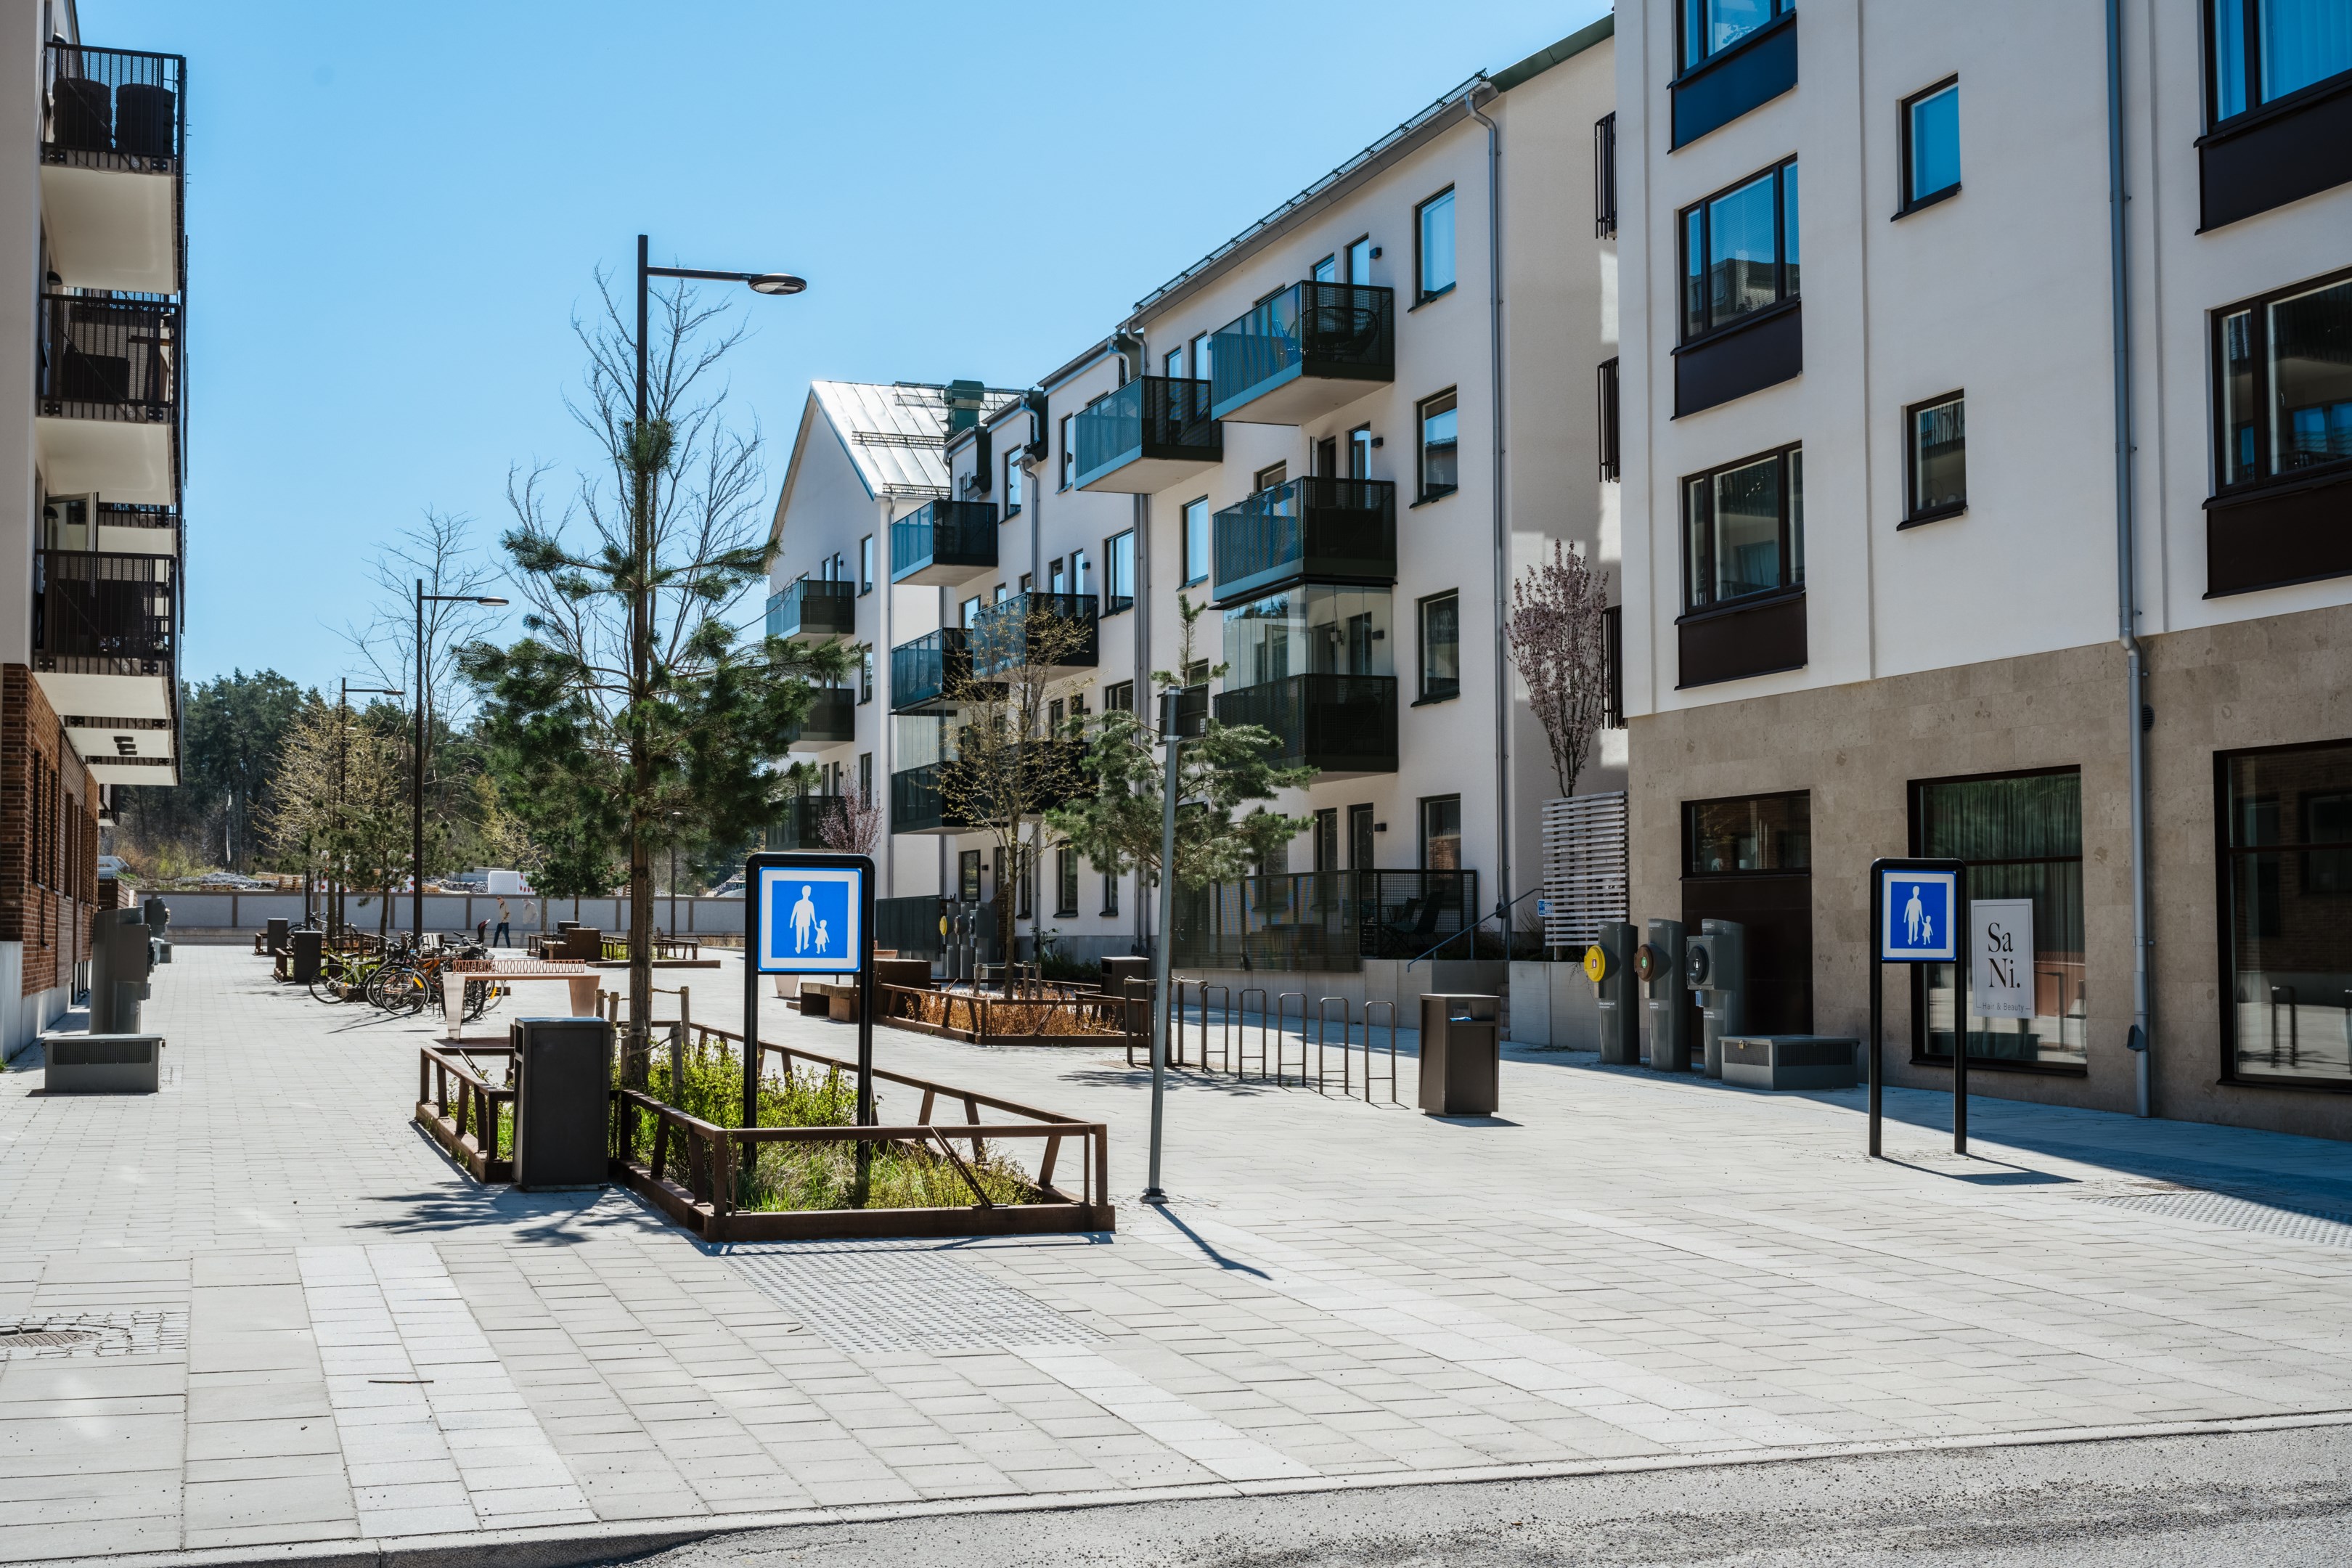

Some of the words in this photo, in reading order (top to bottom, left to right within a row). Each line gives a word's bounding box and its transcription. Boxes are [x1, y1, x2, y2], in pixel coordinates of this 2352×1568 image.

[1988, 922, 2014, 952] Sa
[1988, 957, 2020, 988] Ni.
[2004, 1003, 2025, 1013] Beauty
